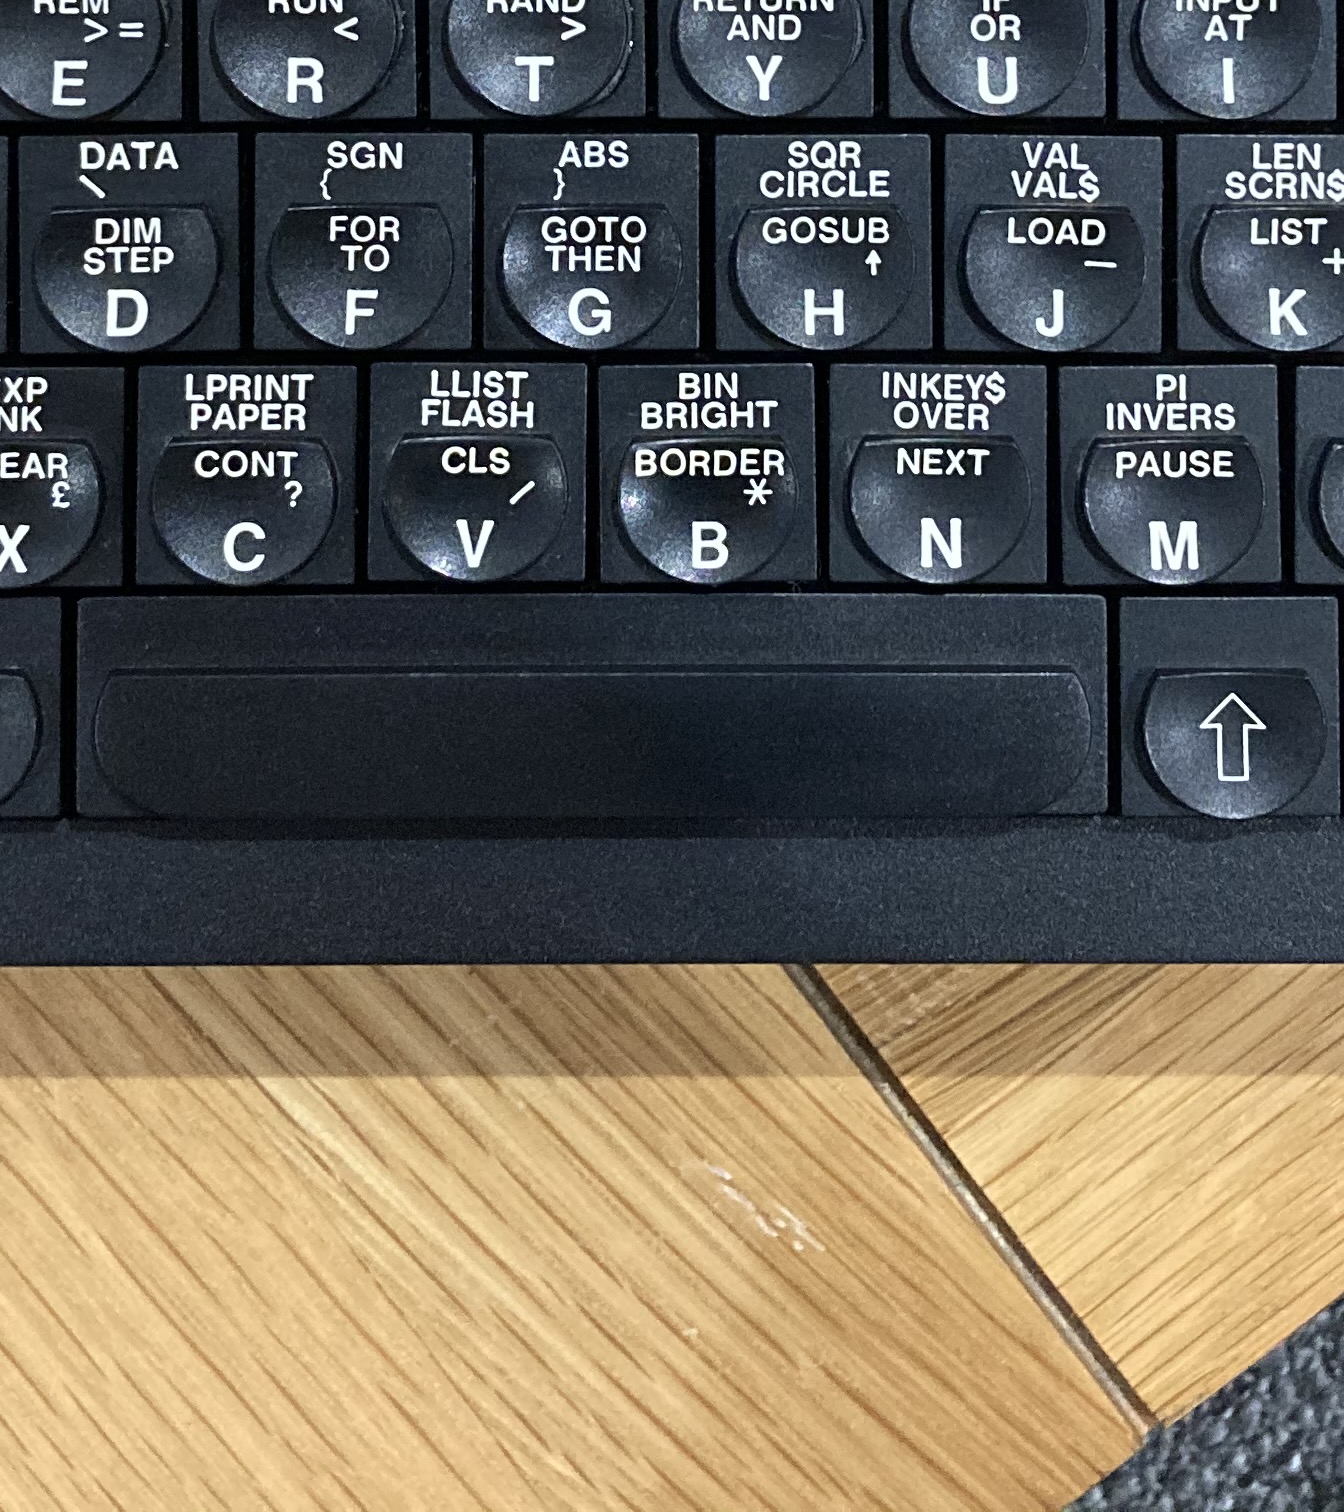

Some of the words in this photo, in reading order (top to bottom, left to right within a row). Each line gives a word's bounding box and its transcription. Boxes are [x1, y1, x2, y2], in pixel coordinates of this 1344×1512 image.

[726, 14, 802, 41] AND
[970, 13, 1021, 42] OR
[1203, 13, 1253, 42] AT
[286, 56, 324, 104] R
[738, 54, 783, 102] Y
[976, 56, 1019, 105] U
[79, 141, 179, 171] DATA
[327, 140, 403, 170] SGN
[558, 140, 629, 169] ABS
[787, 140, 862, 170] SQR
[1021, 140, 1090, 171] VAL
[1252, 142, 1322, 171] LEN
[759, 169, 891, 199] CIRCLE
[1010, 169, 1101, 204] VAL$
[95, 217, 162, 245] DIM
[329, 215, 400, 243] FOR
[541, 215, 647, 244] GOTO
[762, 216, 890, 245] GOSUB
[1007, 216, 1106, 246] LOAD
[1250, 217, 1328, 246] LIST
[83, 246, 175, 276] STEP
[340, 244, 390, 272] TO
[544, 245, 641, 273] THEN
[105, 288, 149, 337] D
[344, 288, 379, 336] F
[566, 287, 614, 337] G
[803, 288, 845, 336] H
[1268, 287, 1309, 337] K
[185, 373, 315, 402] LPRINT
[430, 369, 529, 399] LLIST
[678, 371, 739, 400] BIN
[882, 370, 1006, 405] INKEY$
[1155, 373, 1187, 402] PI
[190, 402, 307, 431] PAPER
[421, 398, 534, 429] FLASH
[640, 400, 779, 430] BRIGHT
[893, 400, 990, 431] OVER
[1105, 402, 1236, 431] INVERS
[194, 449, 299, 478] CONT
[441, 446, 511, 475] CLS
[634, 447, 785, 478] BORDER
[896, 447, 991, 476] NEXT
[1115, 449, 1235, 479] PAUSE
[223, 521, 266, 572] C
[454, 517, 496, 570] V
[688, 521, 729, 570] B
[920, 517, 963, 569] N
[1148, 520, 1200, 571] M
